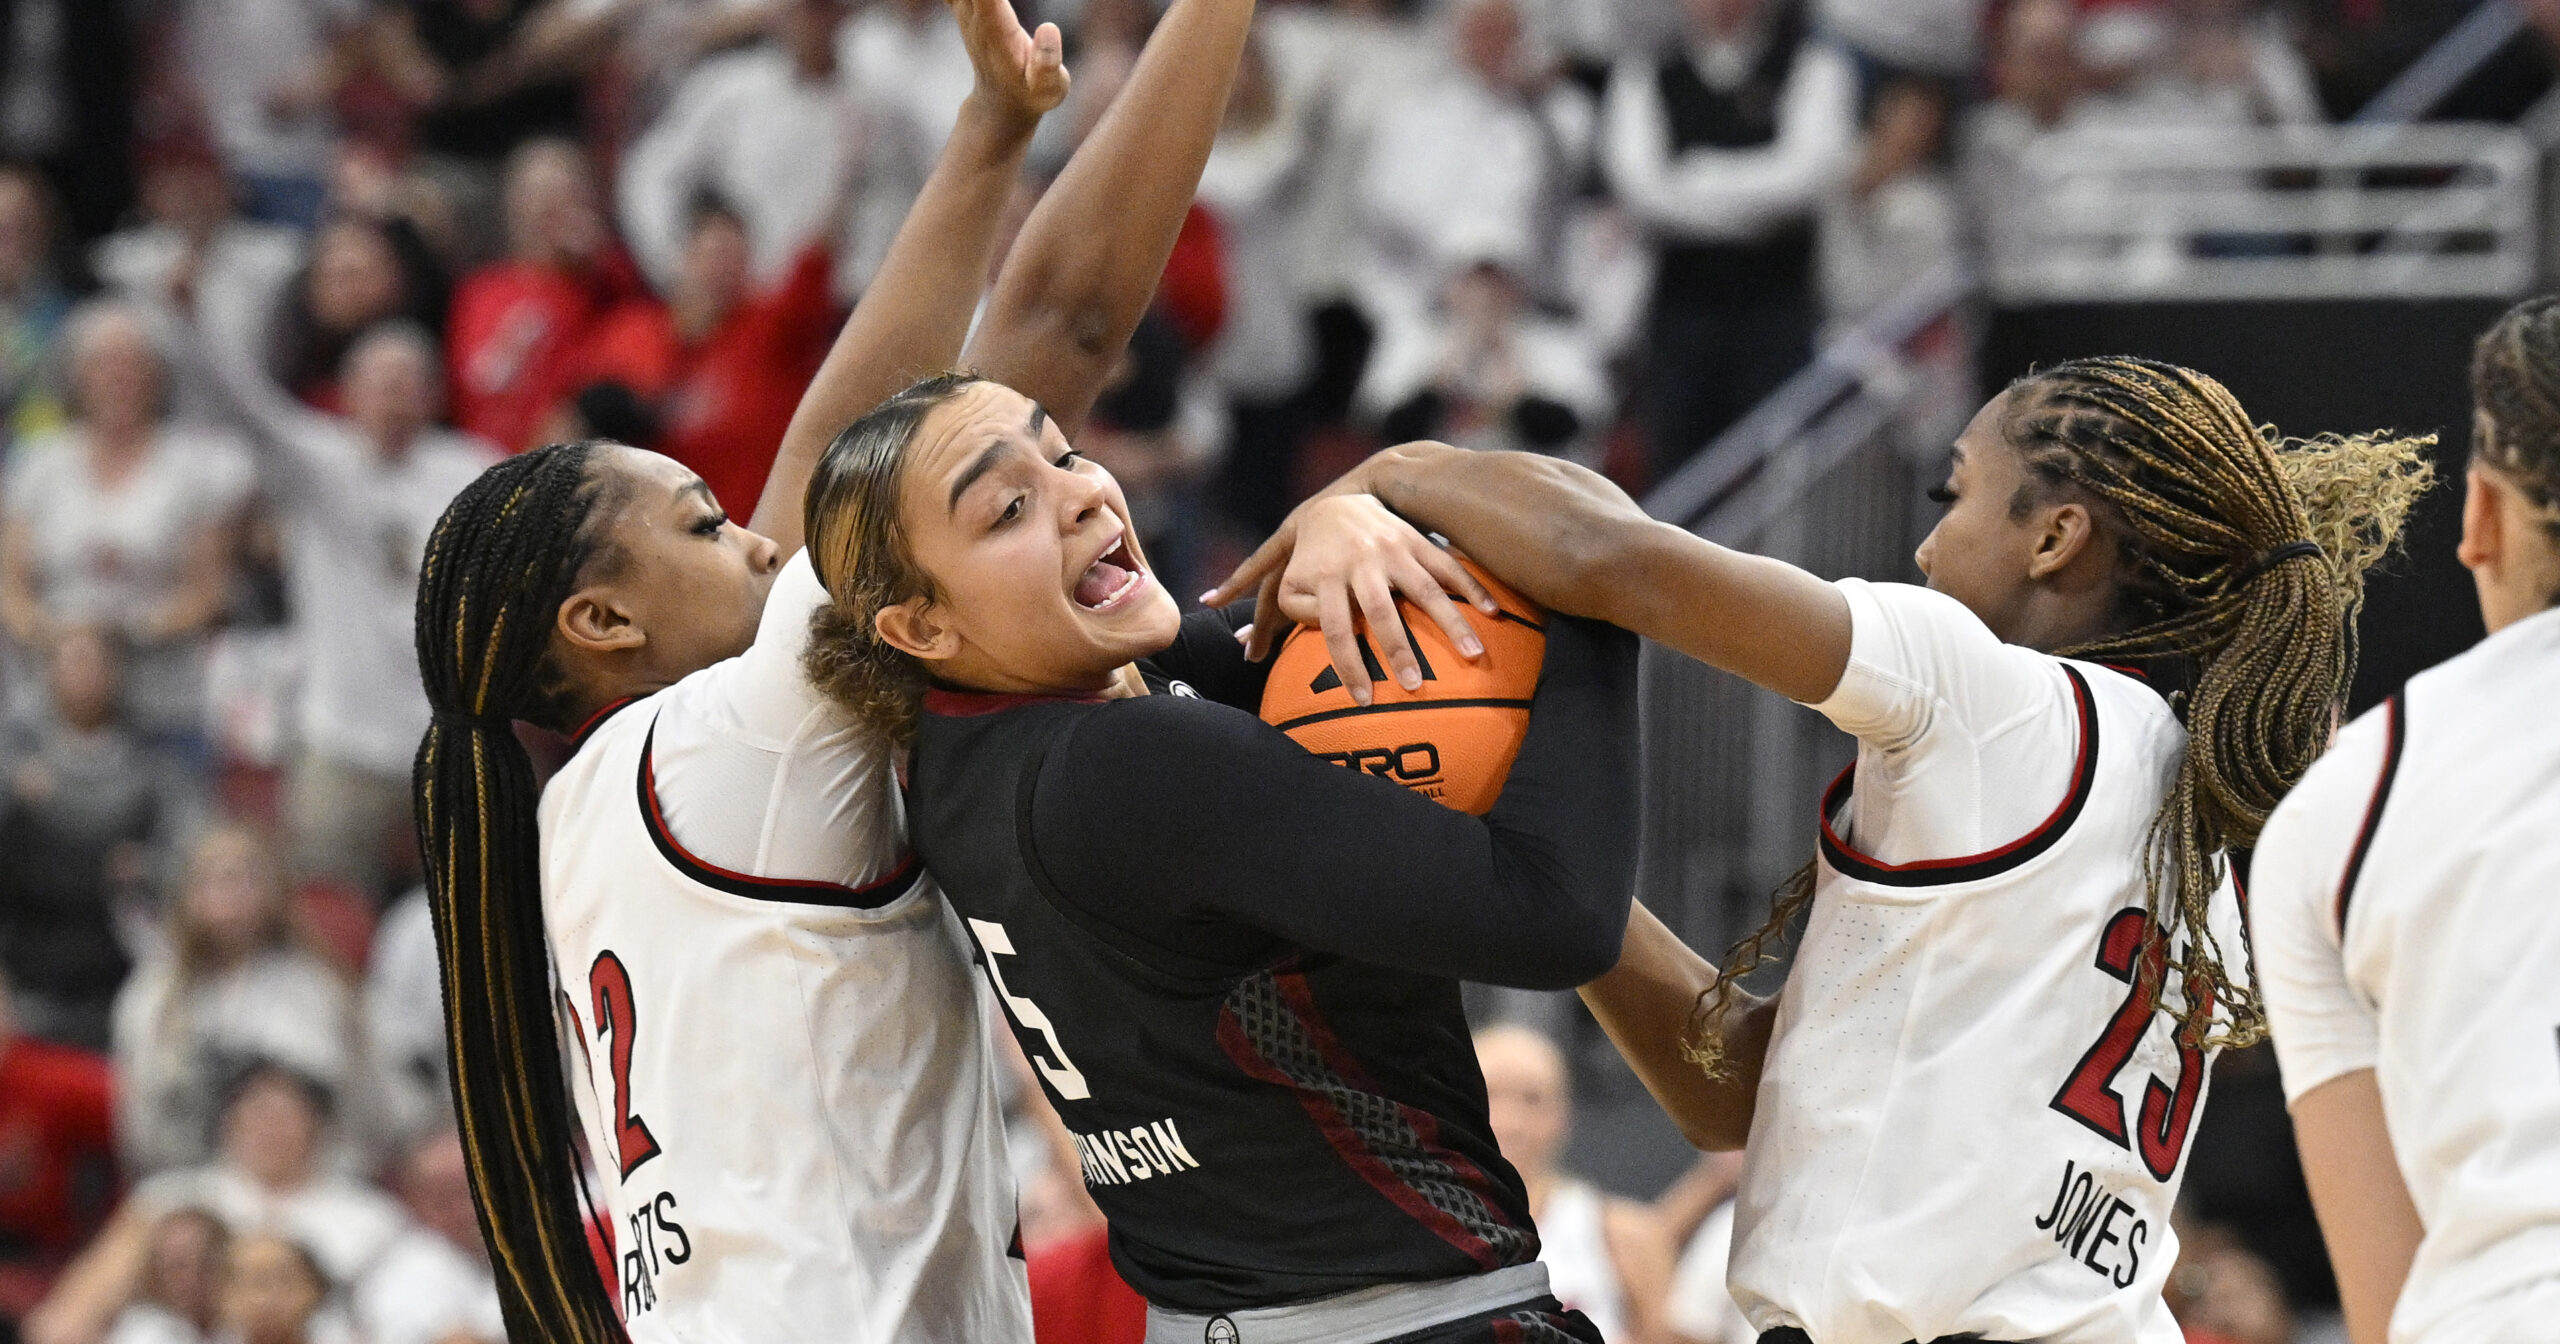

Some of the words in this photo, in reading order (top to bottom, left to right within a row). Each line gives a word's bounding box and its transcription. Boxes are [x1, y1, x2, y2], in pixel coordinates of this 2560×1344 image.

[563, 949, 661, 1186] 2
[1066, 1117, 1201, 1186] HNSON
[2036, 1160, 2147, 1289] JONES
